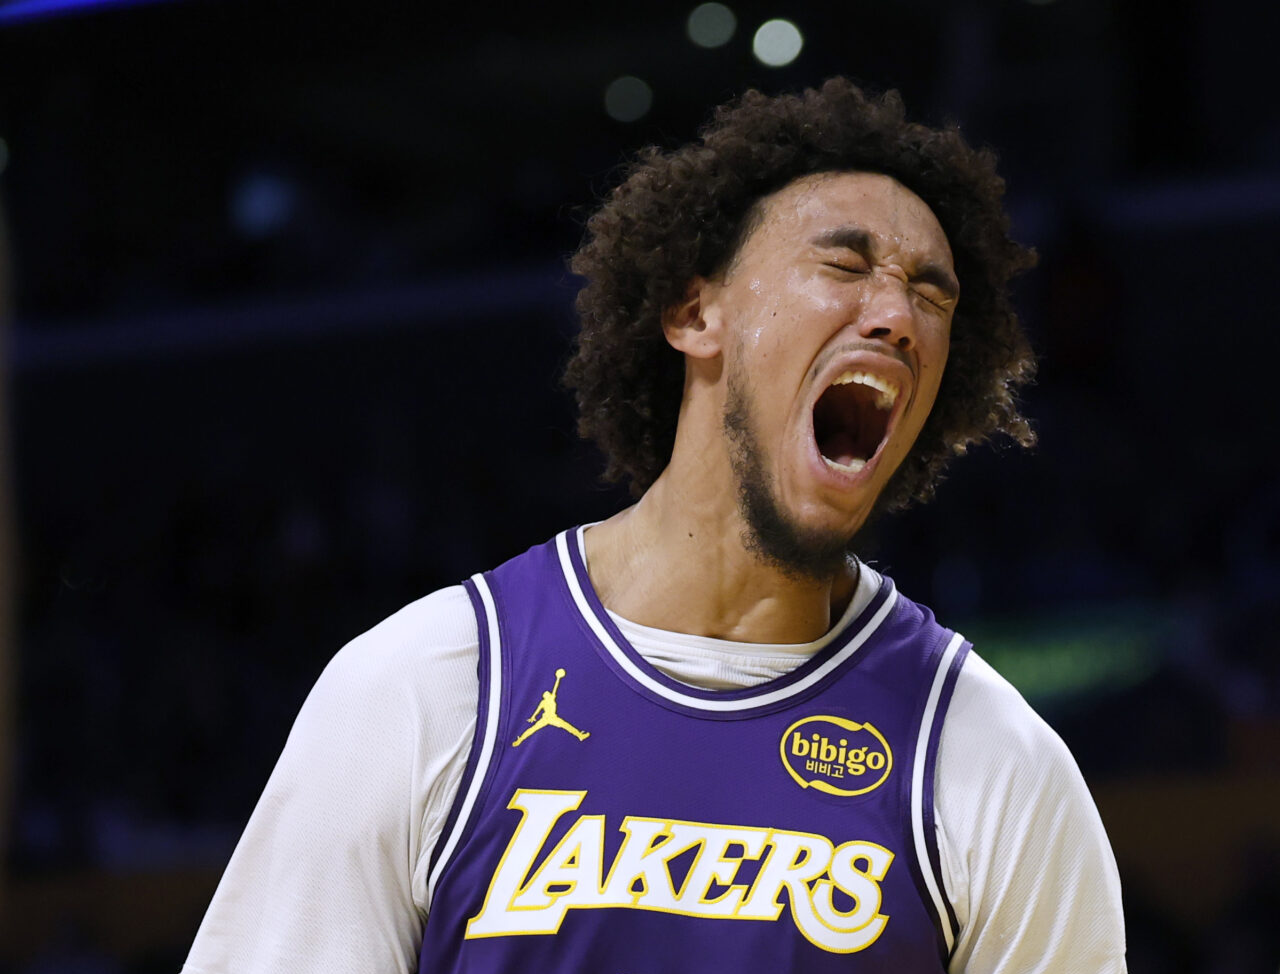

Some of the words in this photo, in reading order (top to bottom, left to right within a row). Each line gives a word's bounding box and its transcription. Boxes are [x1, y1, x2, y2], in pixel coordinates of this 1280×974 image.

[791, 731, 886, 776] bibigo
[805, 759, 845, 779] 비비고
[464, 788, 895, 954] LAKERS
